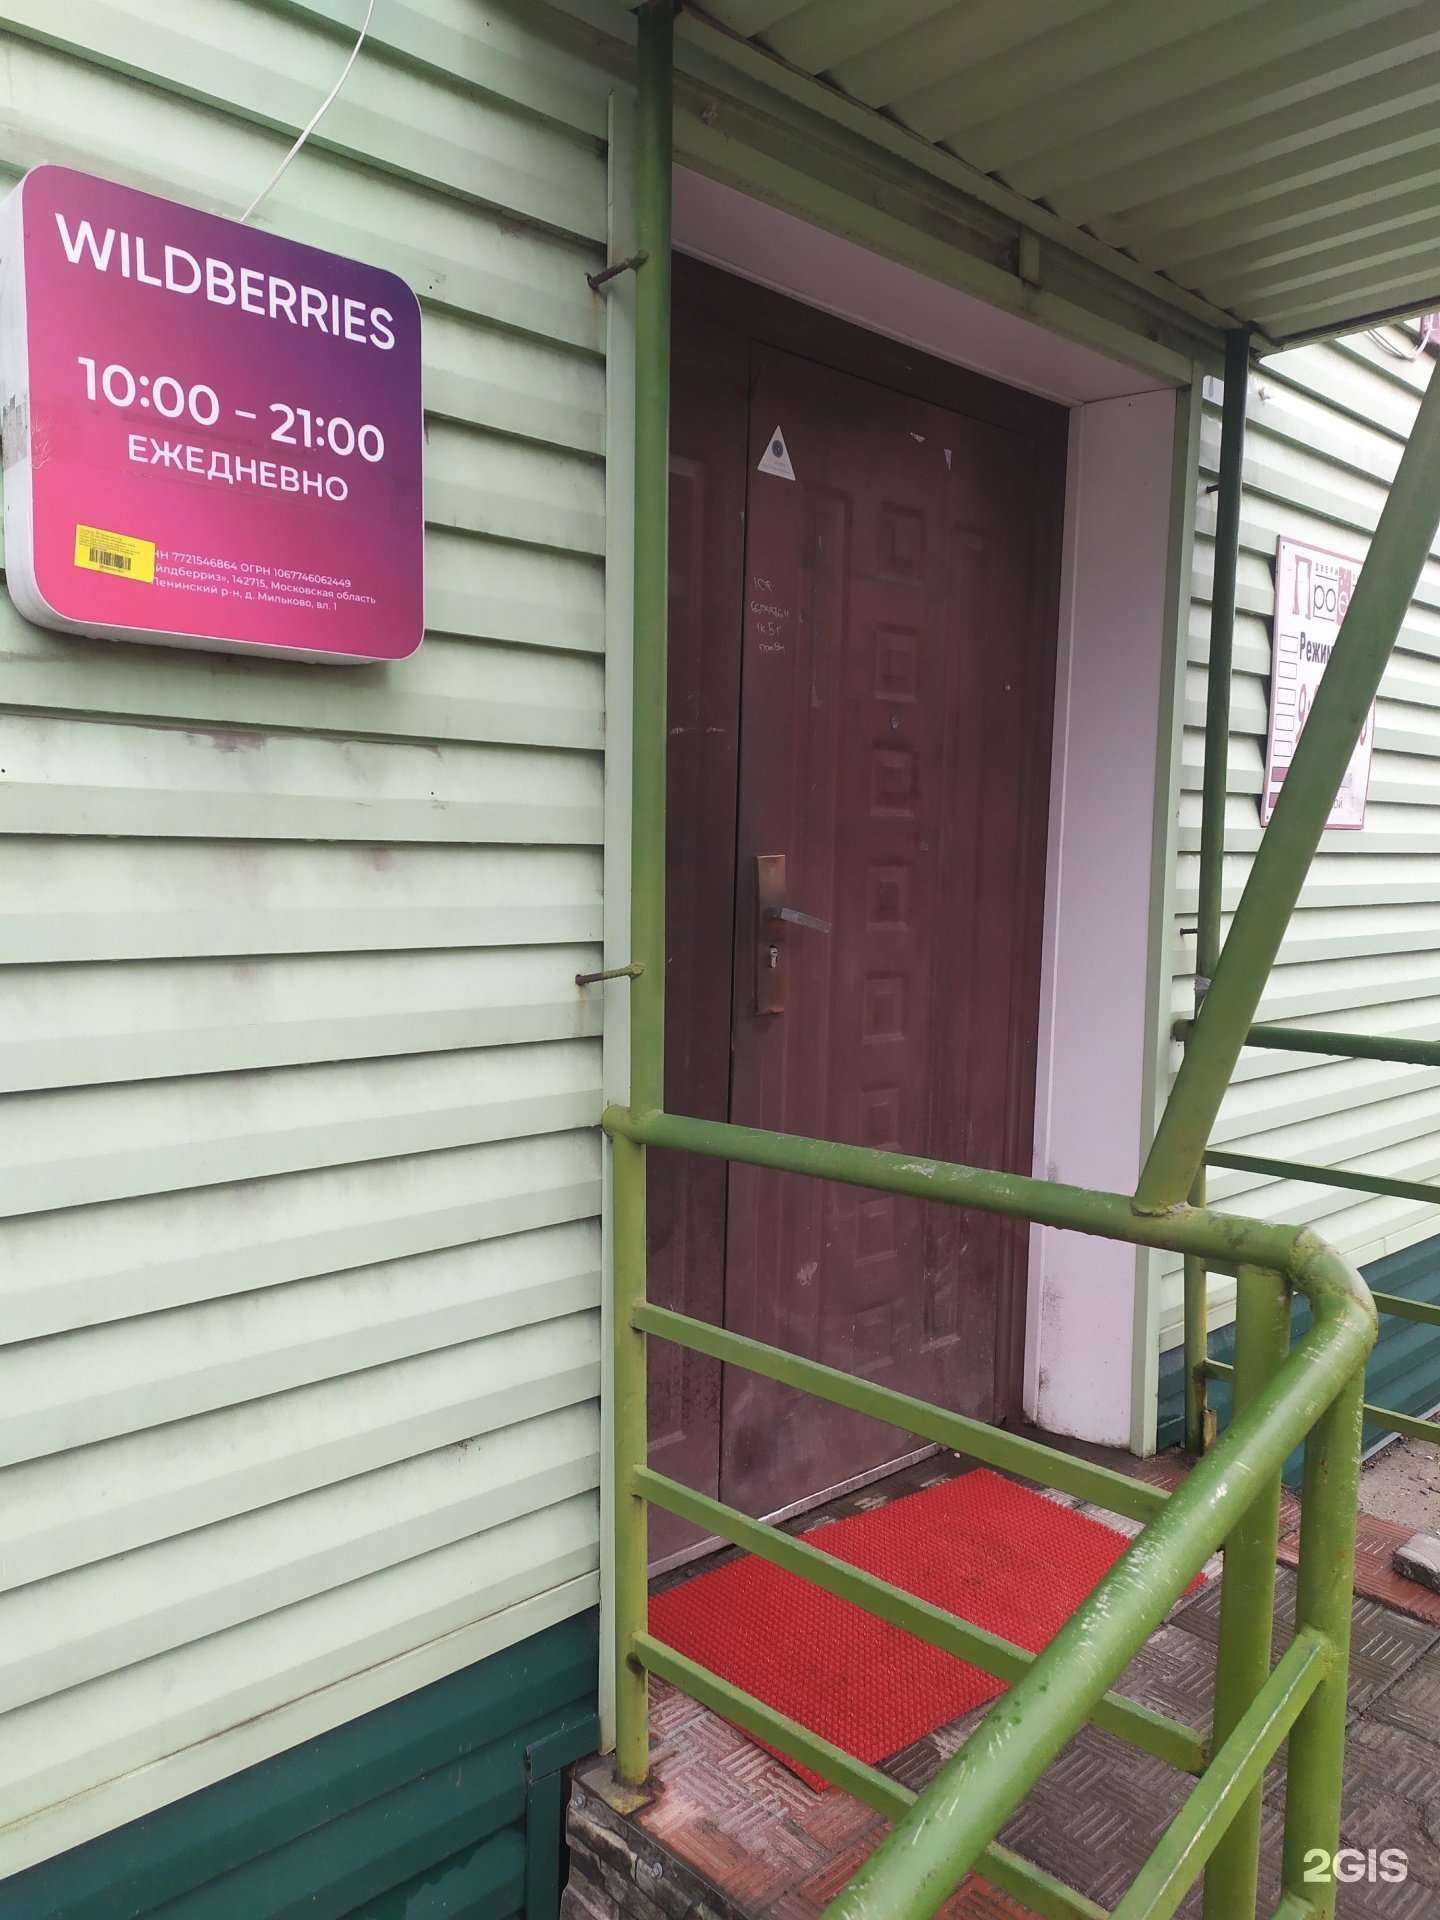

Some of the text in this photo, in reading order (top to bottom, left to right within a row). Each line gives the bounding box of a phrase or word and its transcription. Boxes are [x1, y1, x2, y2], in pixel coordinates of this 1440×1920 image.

[55, 212, 396, 351] WILDBERRIES
[78, 356, 220, 426] 10:00
[269, 403, 385, 463] 21:00
[128, 434, 349, 501] ЕЖЕДНЕВНО
[171, 551, 238, 570] 7721546864
[240, 562, 271, 576] ОГРН
[273, 567, 353, 588] 1067746062449
[271, 581, 334, 598] Московская
[336, 591, 376, 604] область
